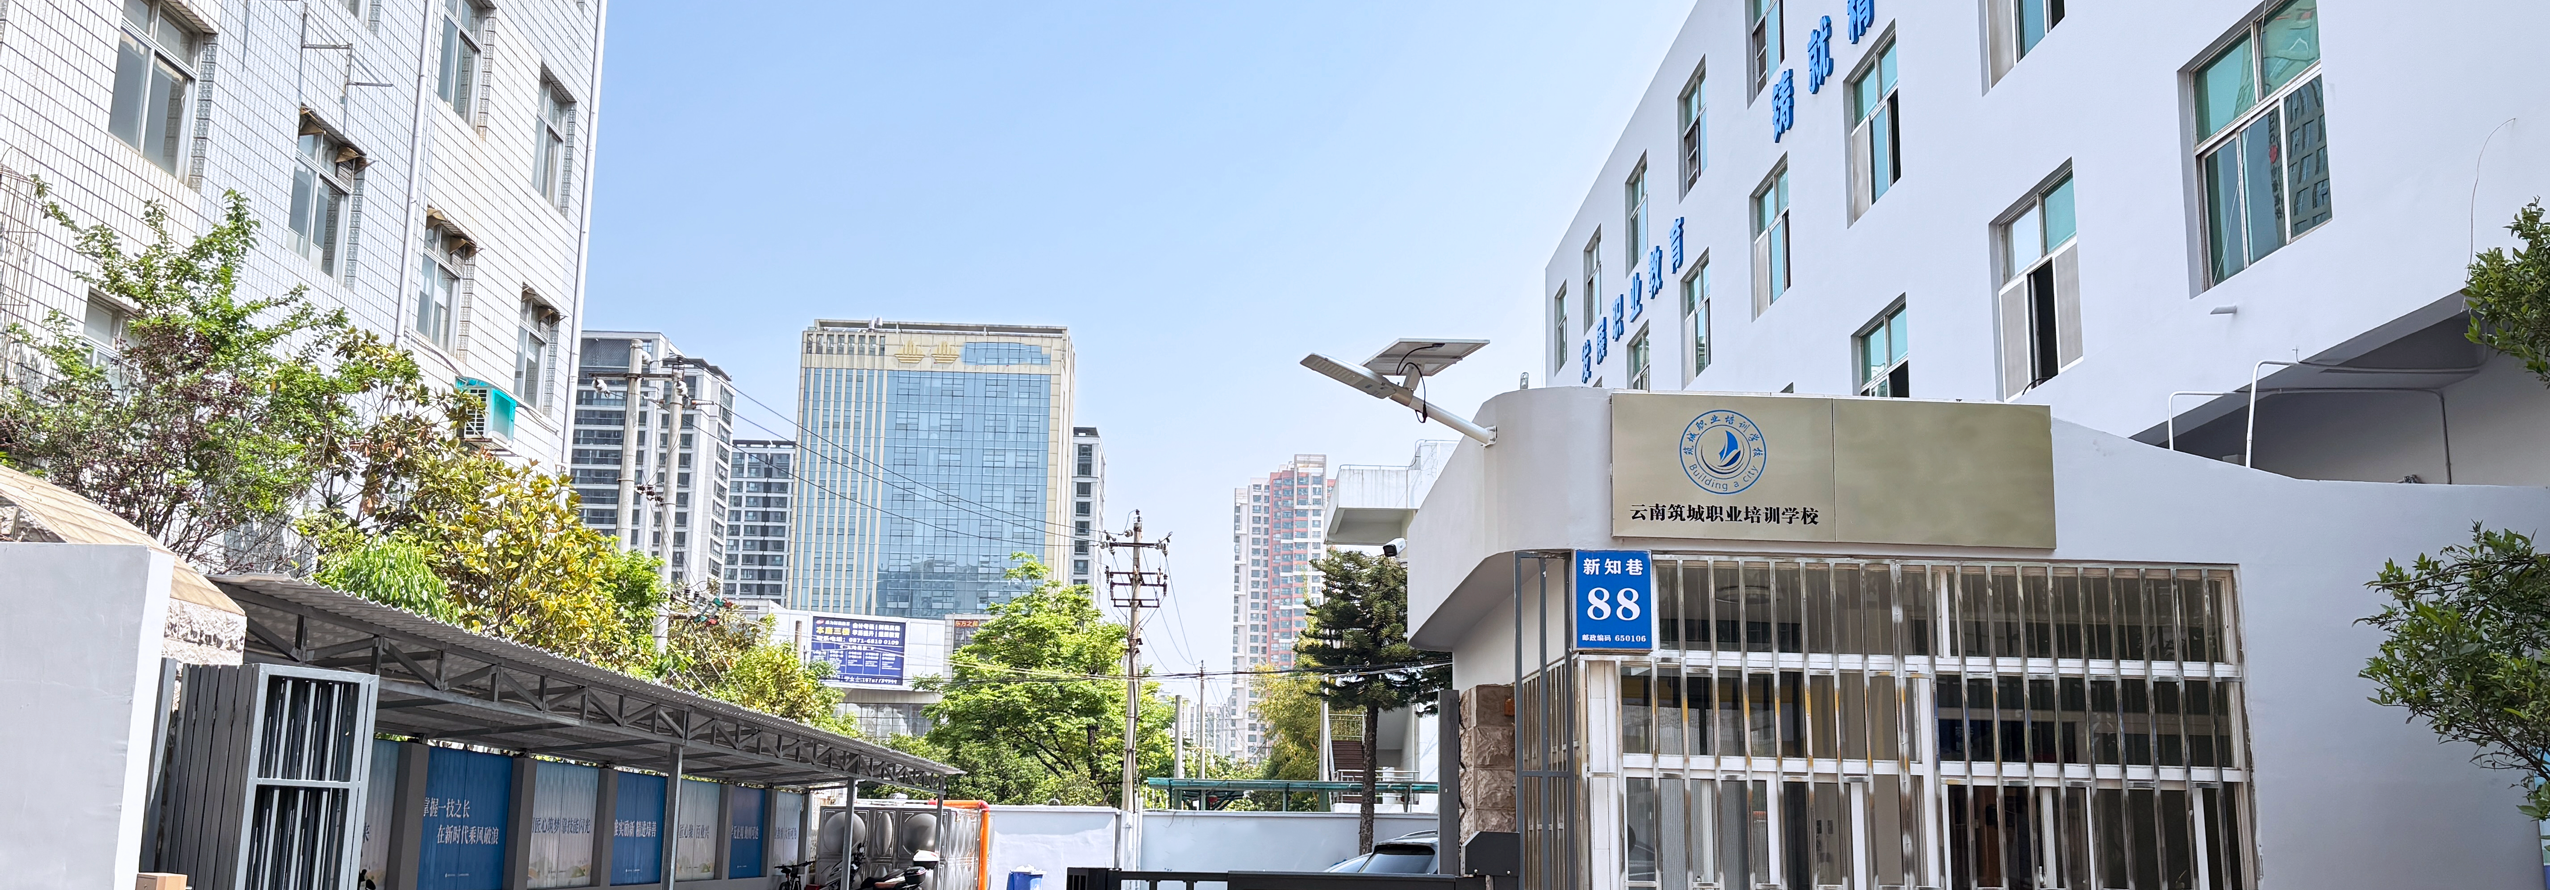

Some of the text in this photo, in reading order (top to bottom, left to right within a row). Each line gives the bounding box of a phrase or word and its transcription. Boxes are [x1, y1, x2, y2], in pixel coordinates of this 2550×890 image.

[1582, 0, 1875, 384] 发展职业教育 铸就精
[1683, 414, 1763, 457] 筑城职业培训学校
[1688, 463, 1728, 491] Building
[1743, 465, 1759, 483] city
[1630, 503, 1819, 526] 云南筑城职业培训学校
[1583, 557, 1643, 576] 新知巷
[1587, 587, 1641, 621] 88
[1582, 633, 1647, 643] 邮政编码 650106
[423, 797, 470, 818] 掌握一技之长
[437, 824, 499, 845] 在新时代乘风破浪
